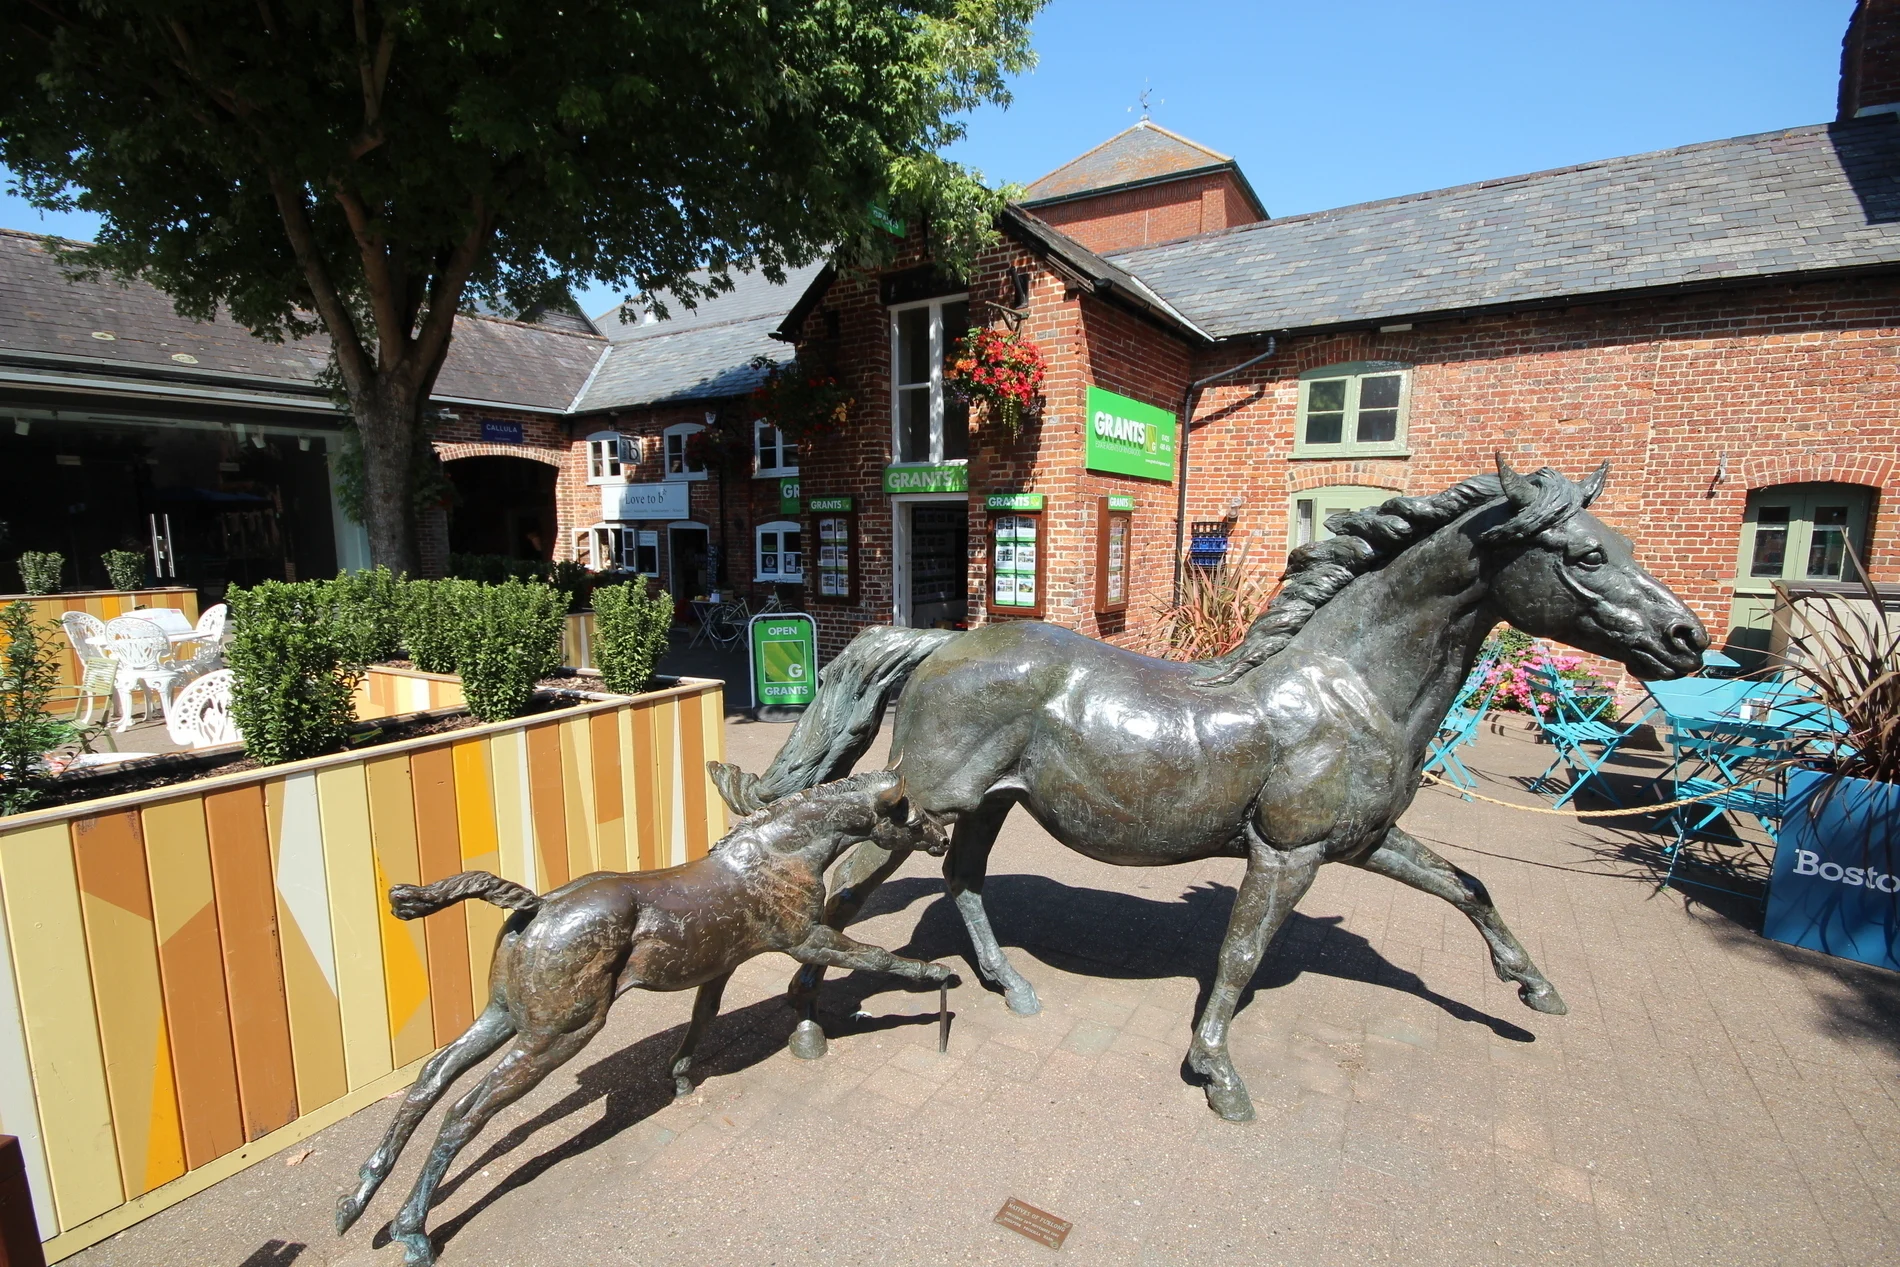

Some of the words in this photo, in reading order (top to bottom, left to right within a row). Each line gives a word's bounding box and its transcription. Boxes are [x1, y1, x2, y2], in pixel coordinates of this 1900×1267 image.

[486, 423, 518, 433] CALLULA
[1094, 411, 1146, 445] GRANTS
[888, 471, 952, 489] GRANTS
[625, 493, 645, 505] Love
[647, 494, 656, 504] to
[658, 492, 664, 504] b
[988, 496, 1030, 507] GRANTS
[1109, 497, 1129, 507] GRANTS
[810, 500, 842, 510] GRANTS
[768, 626, 797, 636] OPEN
[788, 663, 803, 678] G
[764, 686, 808, 696] GRANTS
[1008, 1203, 1031, 1217] NATIVES
[1039, 1217, 1066, 1232] FURLONG
